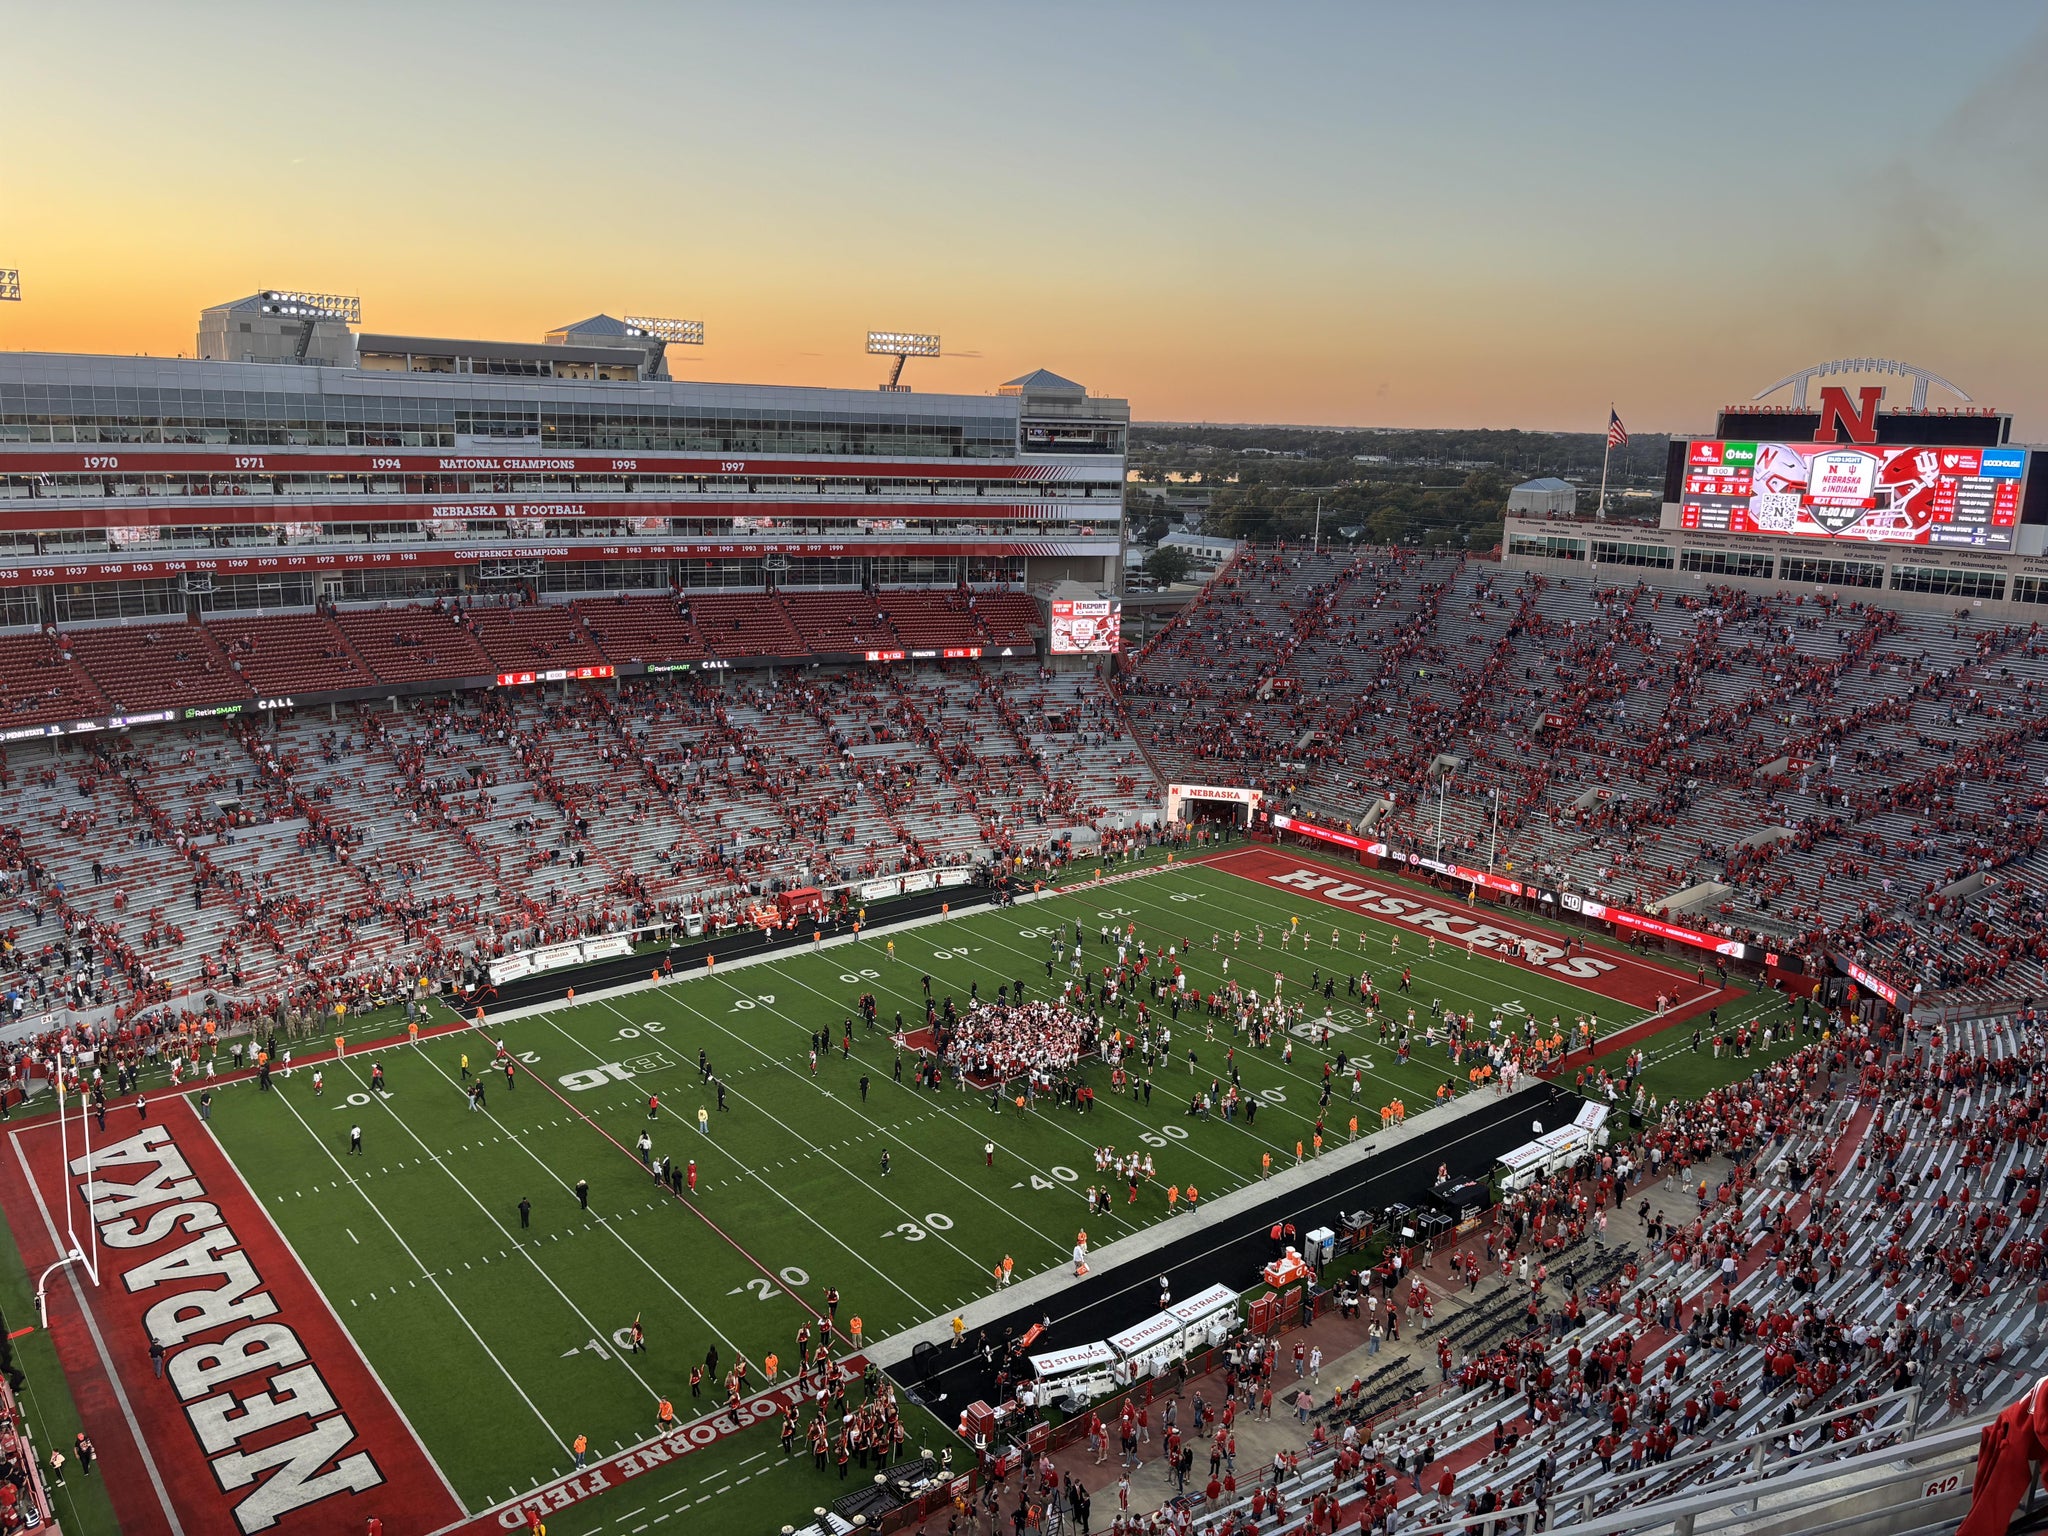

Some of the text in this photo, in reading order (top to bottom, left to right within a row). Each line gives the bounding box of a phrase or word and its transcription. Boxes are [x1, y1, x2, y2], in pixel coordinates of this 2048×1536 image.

[1724, 386, 1996, 444] MEMORIAL N STADIUM
[84, 457, 118, 470] 1970
[235, 457, 264, 470] 1971
[372, 459, 400, 469] 1994
[439, 460, 575, 470] NATIONAL CHAMPIONS
[612, 460, 637, 470] 1995
[721, 462, 745, 472] 1997
[1983, 460, 2021, 468] WOODHOUSE
[1829, 465, 1838, 474] N
[1822, 475, 1862, 485] NEBRASKA
[1691, 482, 1701, 494] N
[1704, 483, 1717, 494] 48
[1722, 484, 1734, 494] 23
[1828, 485, 1858, 494] INDIANA
[433, 505, 587, 516] NEBRASKA N FOOTBALL
[1818, 507, 1855, 518] 11:00 AM
[1826, 518, 1844, 527] FOX
[454, 549, 569, 559] CONFERENCE CHAMPIONS
[100, 566, 122, 574] 1940
[165, 562, 187, 570] 1964
[196, 561, 217, 569] 1966
[0, 570, 19, 578] 935
[32, 570, 54, 578] 1936
[66, 567, 88, 576] 1937
[1076, 602, 1082, 610] N
[869, 650, 879, 660] N
[655, 664, 691, 672] RetireSMART
[702, 660, 731, 669] CALL
[600, 667, 608, 676] M
[505, 675, 514, 685] N
[259, 698, 294, 710] CALL
[195, 706, 242, 717] RetireSMART
[51, 725, 61, 734] 13
[77, 721, 97, 731] FINAL
[6, 728, 45, 740] PENN STATE
[1171, 787, 1179, 795] N
[1190, 788, 1241, 799] NEBRASKA
[1392, 850, 1407, 862] 0:00
[1527, 887, 1537, 898] N
[812, 899, 820, 908] N
[1563, 894, 1580, 909] 40
[1097, 908, 1132, 920] 20
[1268, 868, 1618, 980] HUSKERS
[1617, 914, 1635, 923] KEEP
[1665, 927, 1703, 942] NEBRASKA.
[1018, 926, 1056, 942] 30
[593, 941, 618, 950] NEBRASKA
[934, 947, 969, 960] 40
[1765, 952, 1778, 966] N
[840, 969, 881, 983] 50
[735, 994, 776, 1010] 40
[1491, 1001, 1527, 1017] 10
[618, 1021, 666, 1039] 30
[346, 1087, 396, 1107] 10
[1139, 1125, 1189, 1148] 50
[1031, 1165, 1079, 1192] 40
[896, 1211, 954, 1242] 30
[746, 1266, 811, 1301] 20
[1280, 1274, 1287, 1285] G
[1189, 1289, 1230, 1315] STRAUSS
[68, 1123, 386, 1536] NEBRASKA
[1131, 1317, 1174, 1343] STRAUSS
[584, 1327, 646, 1361] 10
[1055, 1348, 1108, 1367] STRAUSS
[615, 1398, 779, 1491] OSBORNE
[1926, 1475, 1959, 1498] 612
[498, 1469, 613, 1529] FIELD
